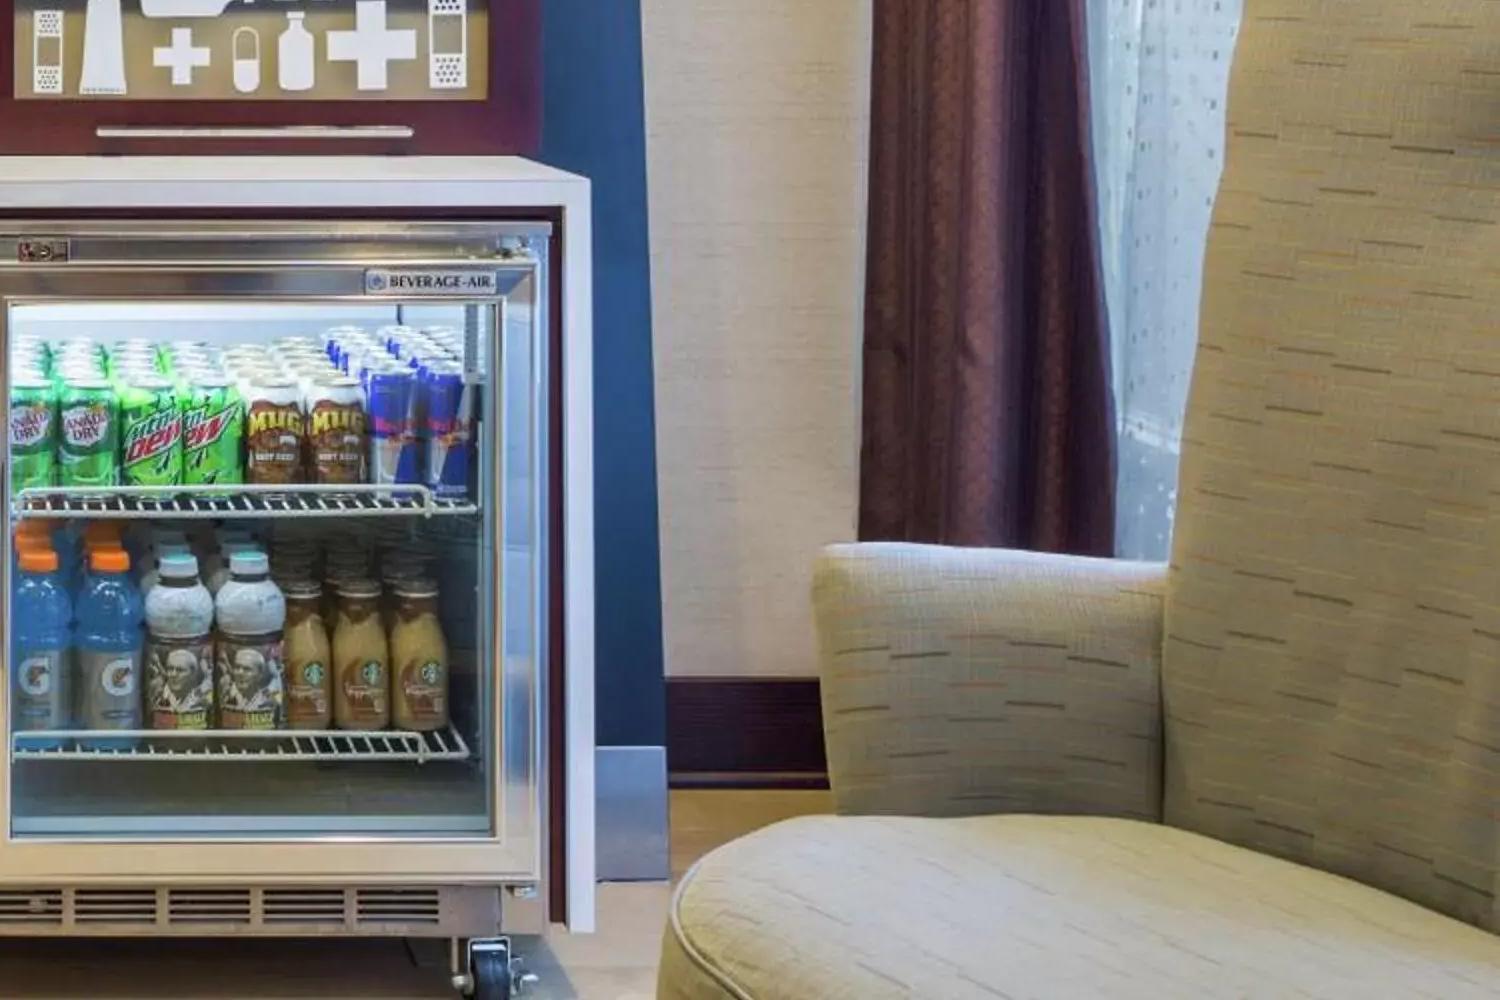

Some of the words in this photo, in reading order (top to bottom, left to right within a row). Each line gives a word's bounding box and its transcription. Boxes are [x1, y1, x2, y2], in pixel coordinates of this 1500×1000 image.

[249, 409, 304, 437] MUG
[312, 409, 365, 437] MUG
[18, 657, 50, 696] G
[102, 657, 132, 696] G
